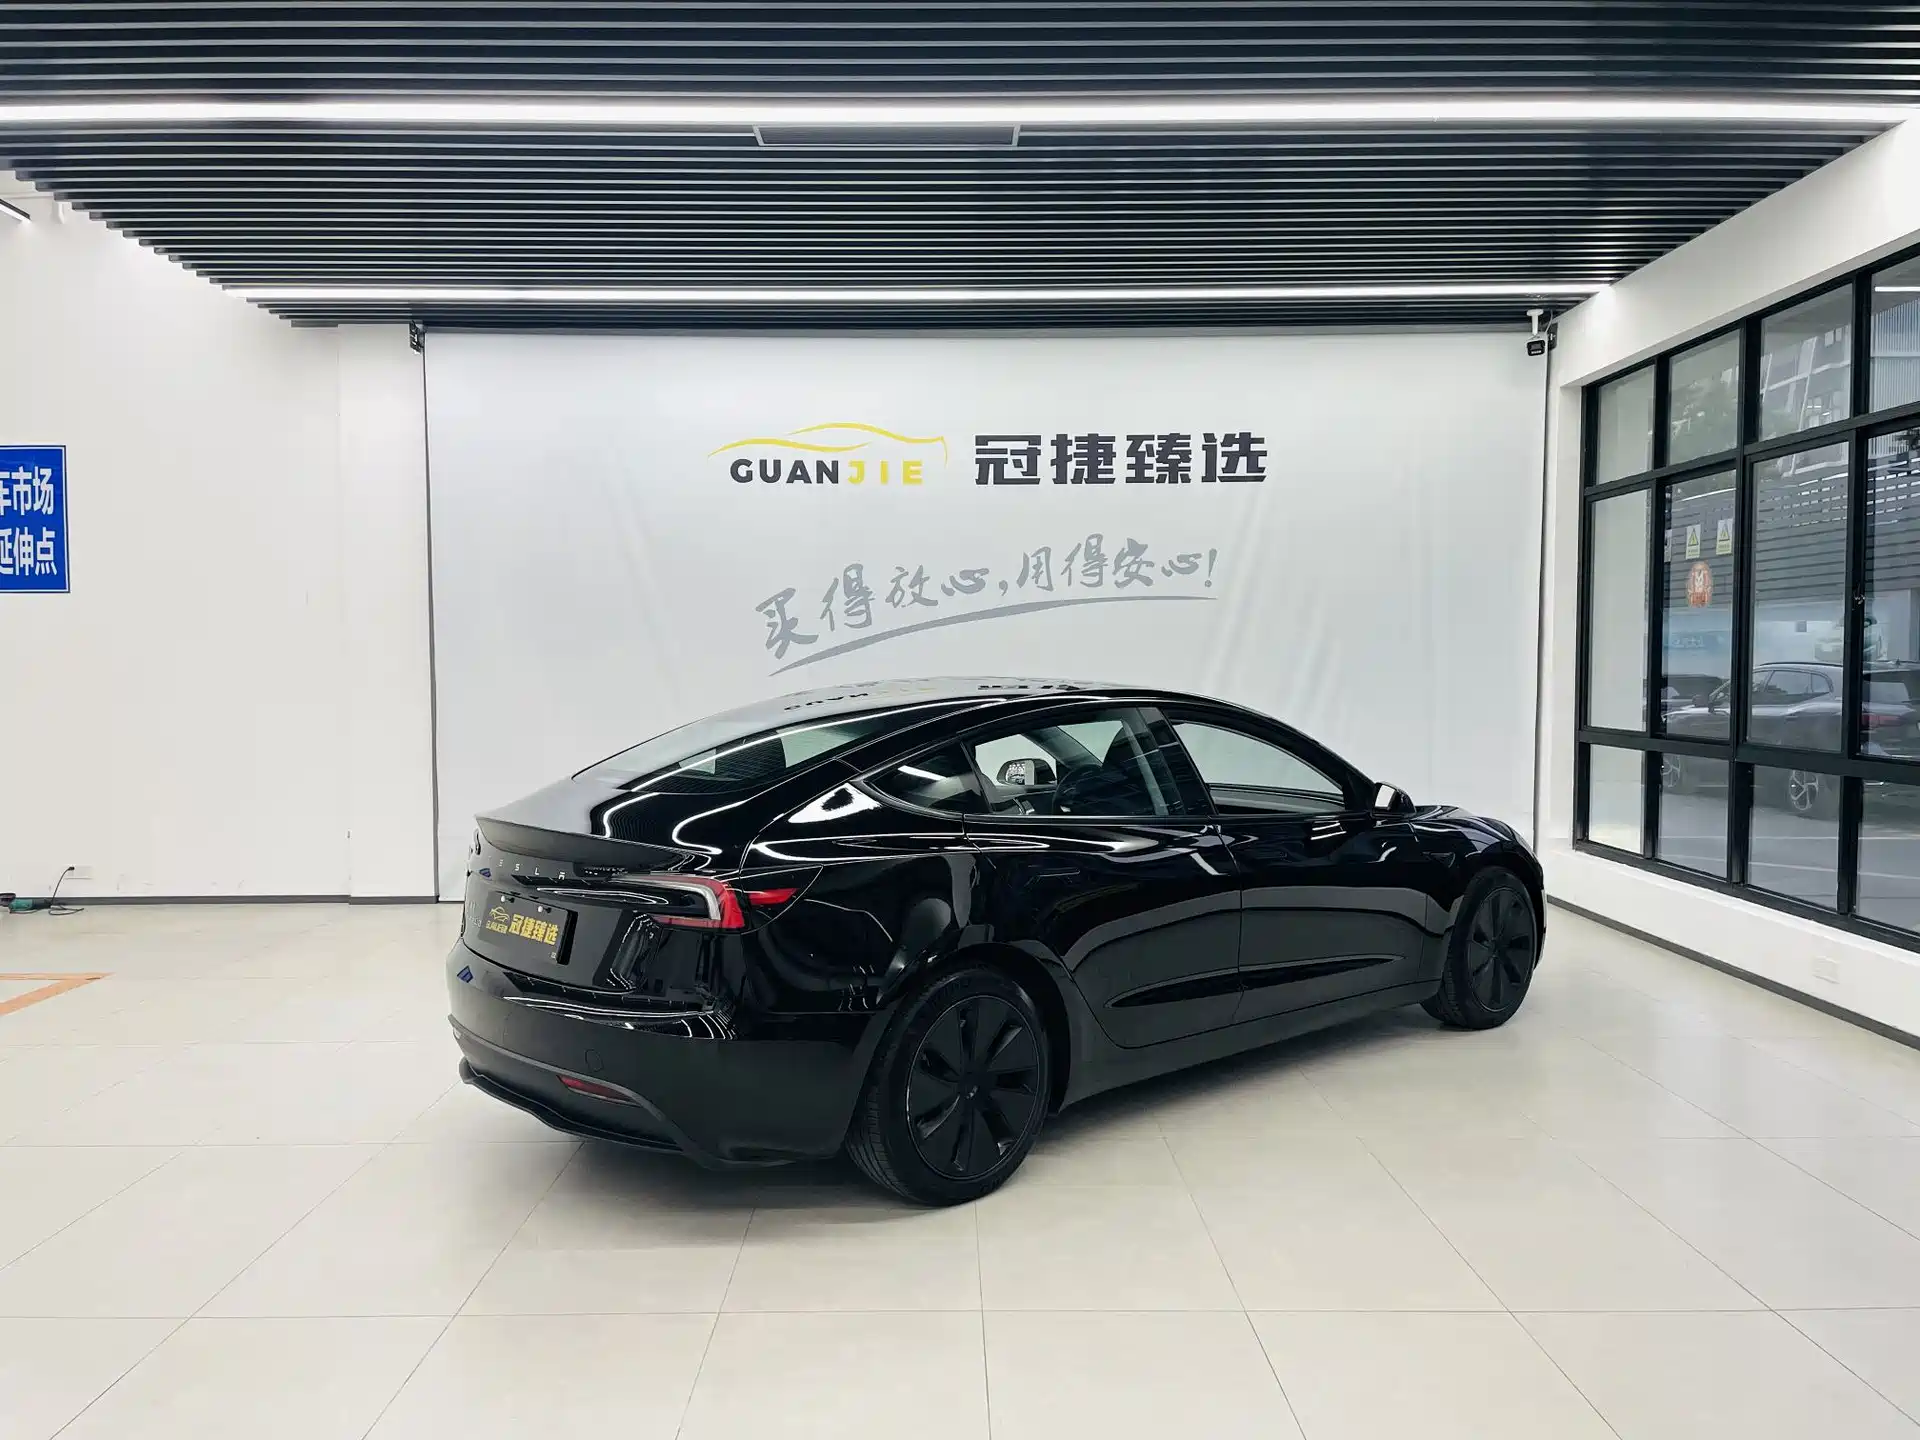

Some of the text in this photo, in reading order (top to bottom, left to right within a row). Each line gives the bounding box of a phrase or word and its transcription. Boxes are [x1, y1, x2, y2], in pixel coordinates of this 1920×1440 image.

[730, 458, 922, 485] GUANJIE
[975, 431, 1267, 485] 冠捷臻选
